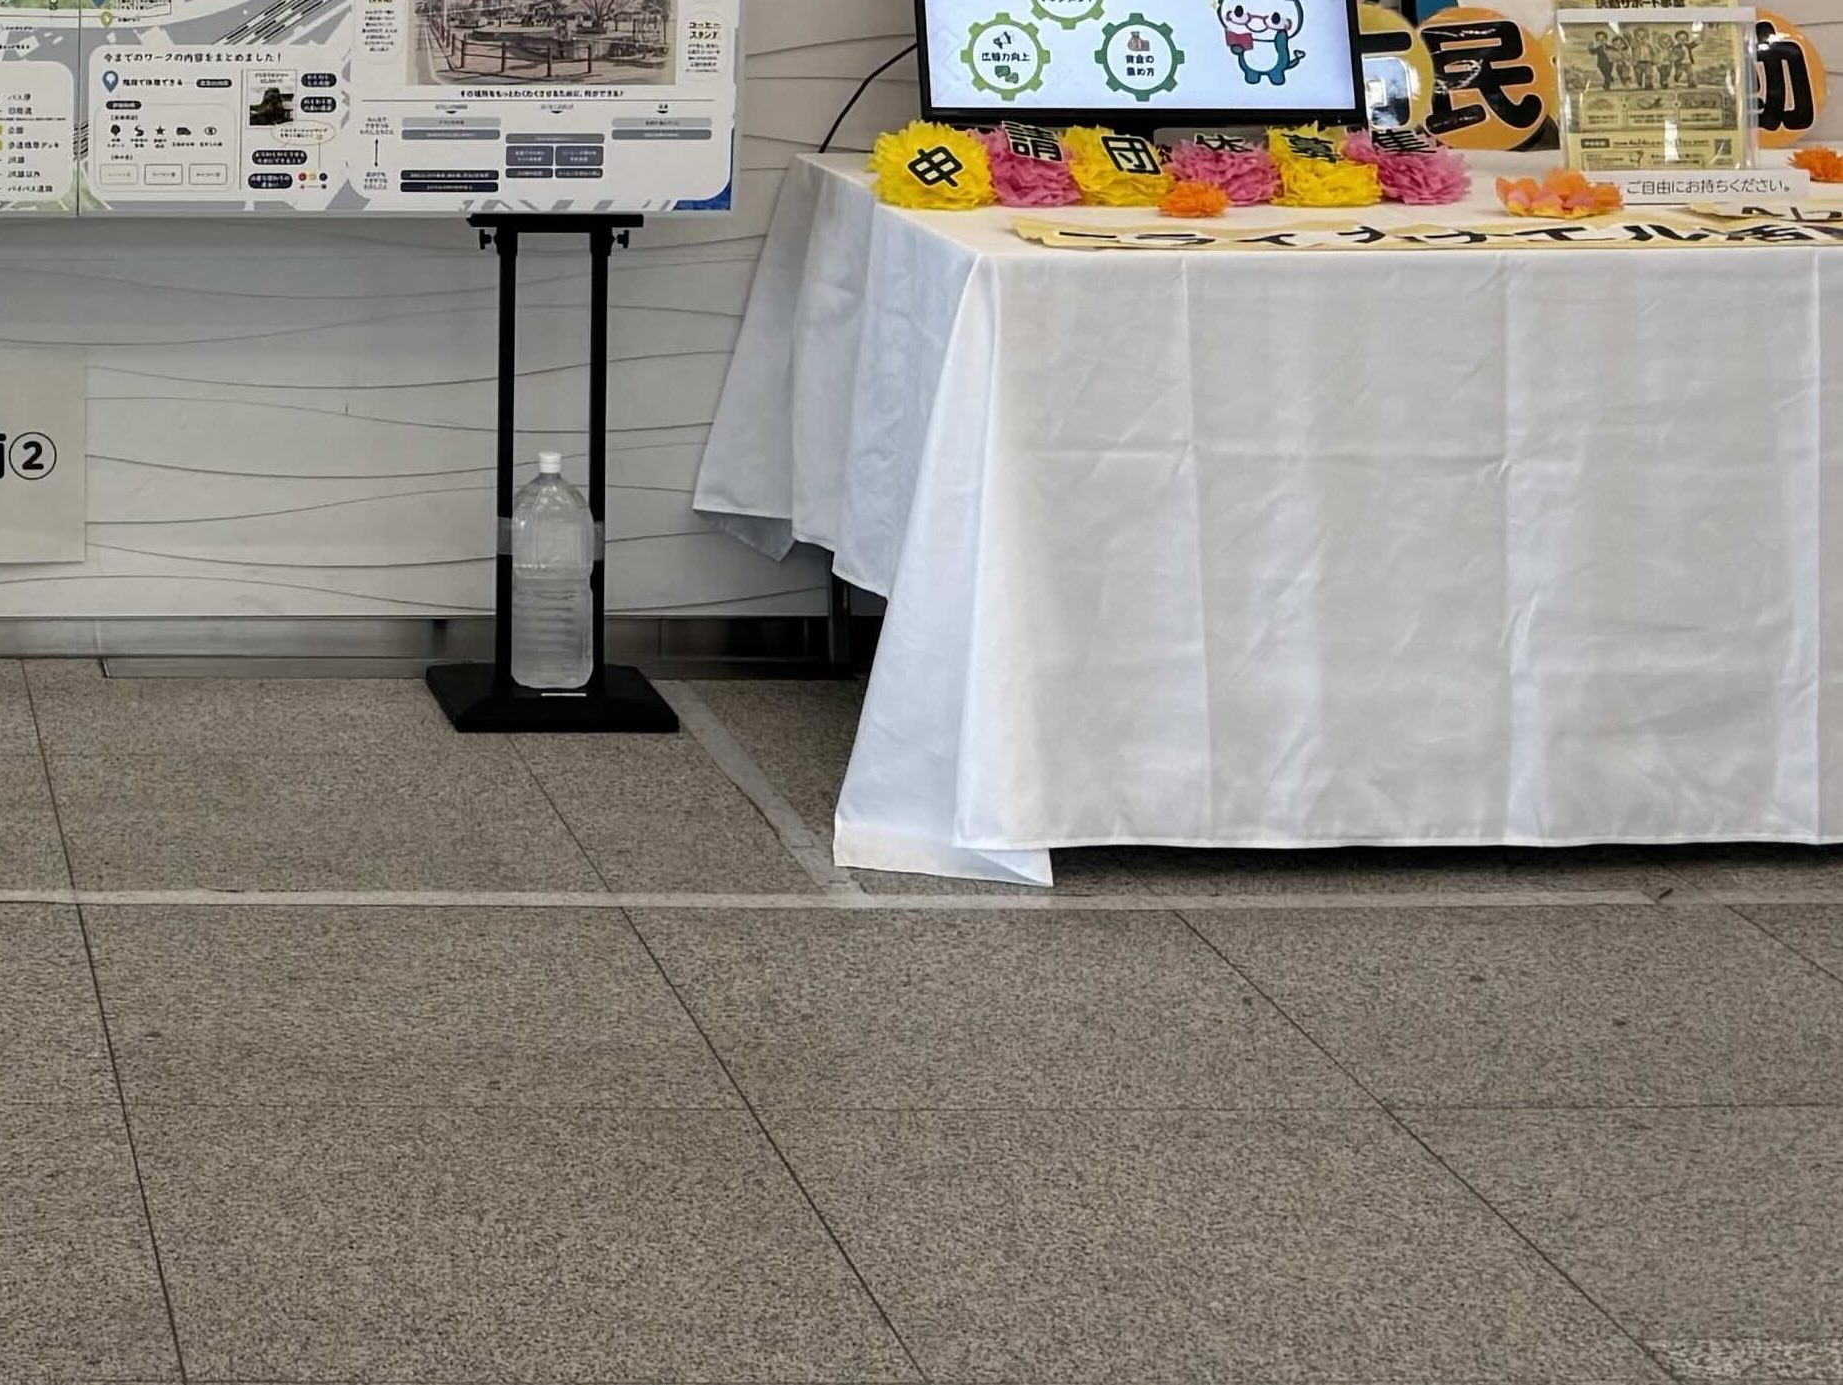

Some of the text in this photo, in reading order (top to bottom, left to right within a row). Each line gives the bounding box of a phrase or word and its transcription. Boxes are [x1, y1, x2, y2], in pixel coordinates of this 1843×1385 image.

[1626, 177, 1792, 196] ご自由にお持ちください。
